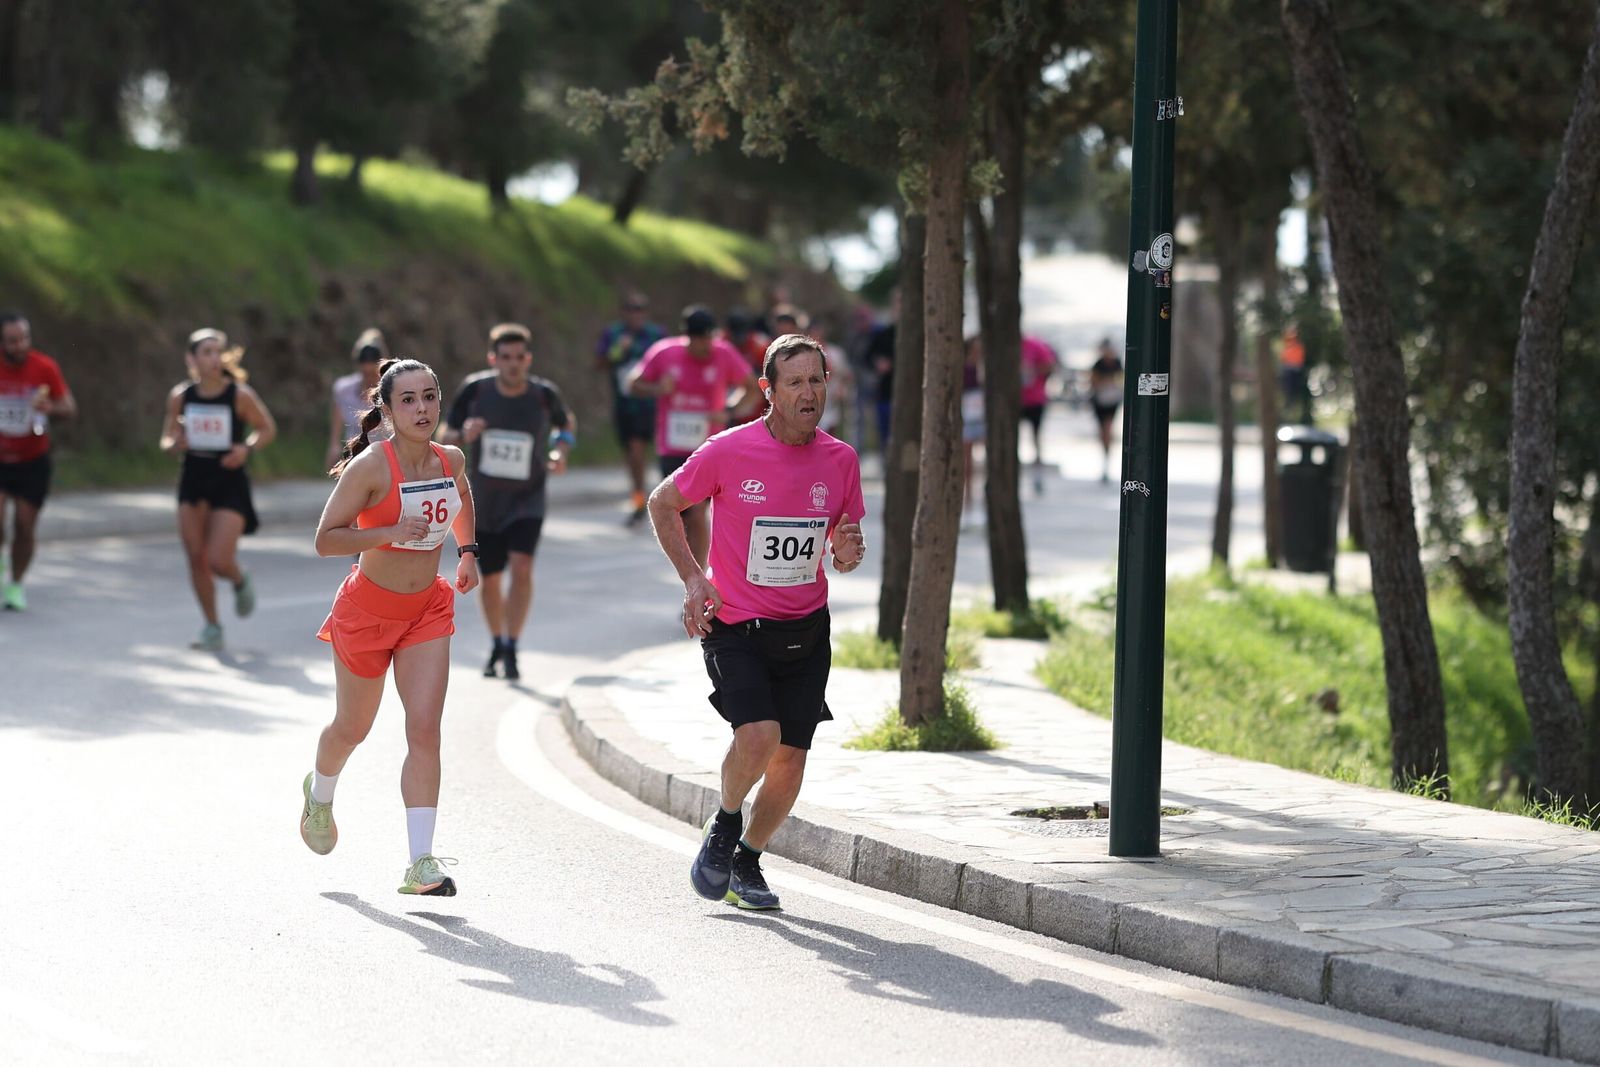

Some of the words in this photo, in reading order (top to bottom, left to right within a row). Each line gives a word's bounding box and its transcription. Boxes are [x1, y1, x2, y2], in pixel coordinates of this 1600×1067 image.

[739, 493, 766, 502] HYUNDAI
[421, 498, 448, 525] 36
[763, 536, 815, 561] 304
